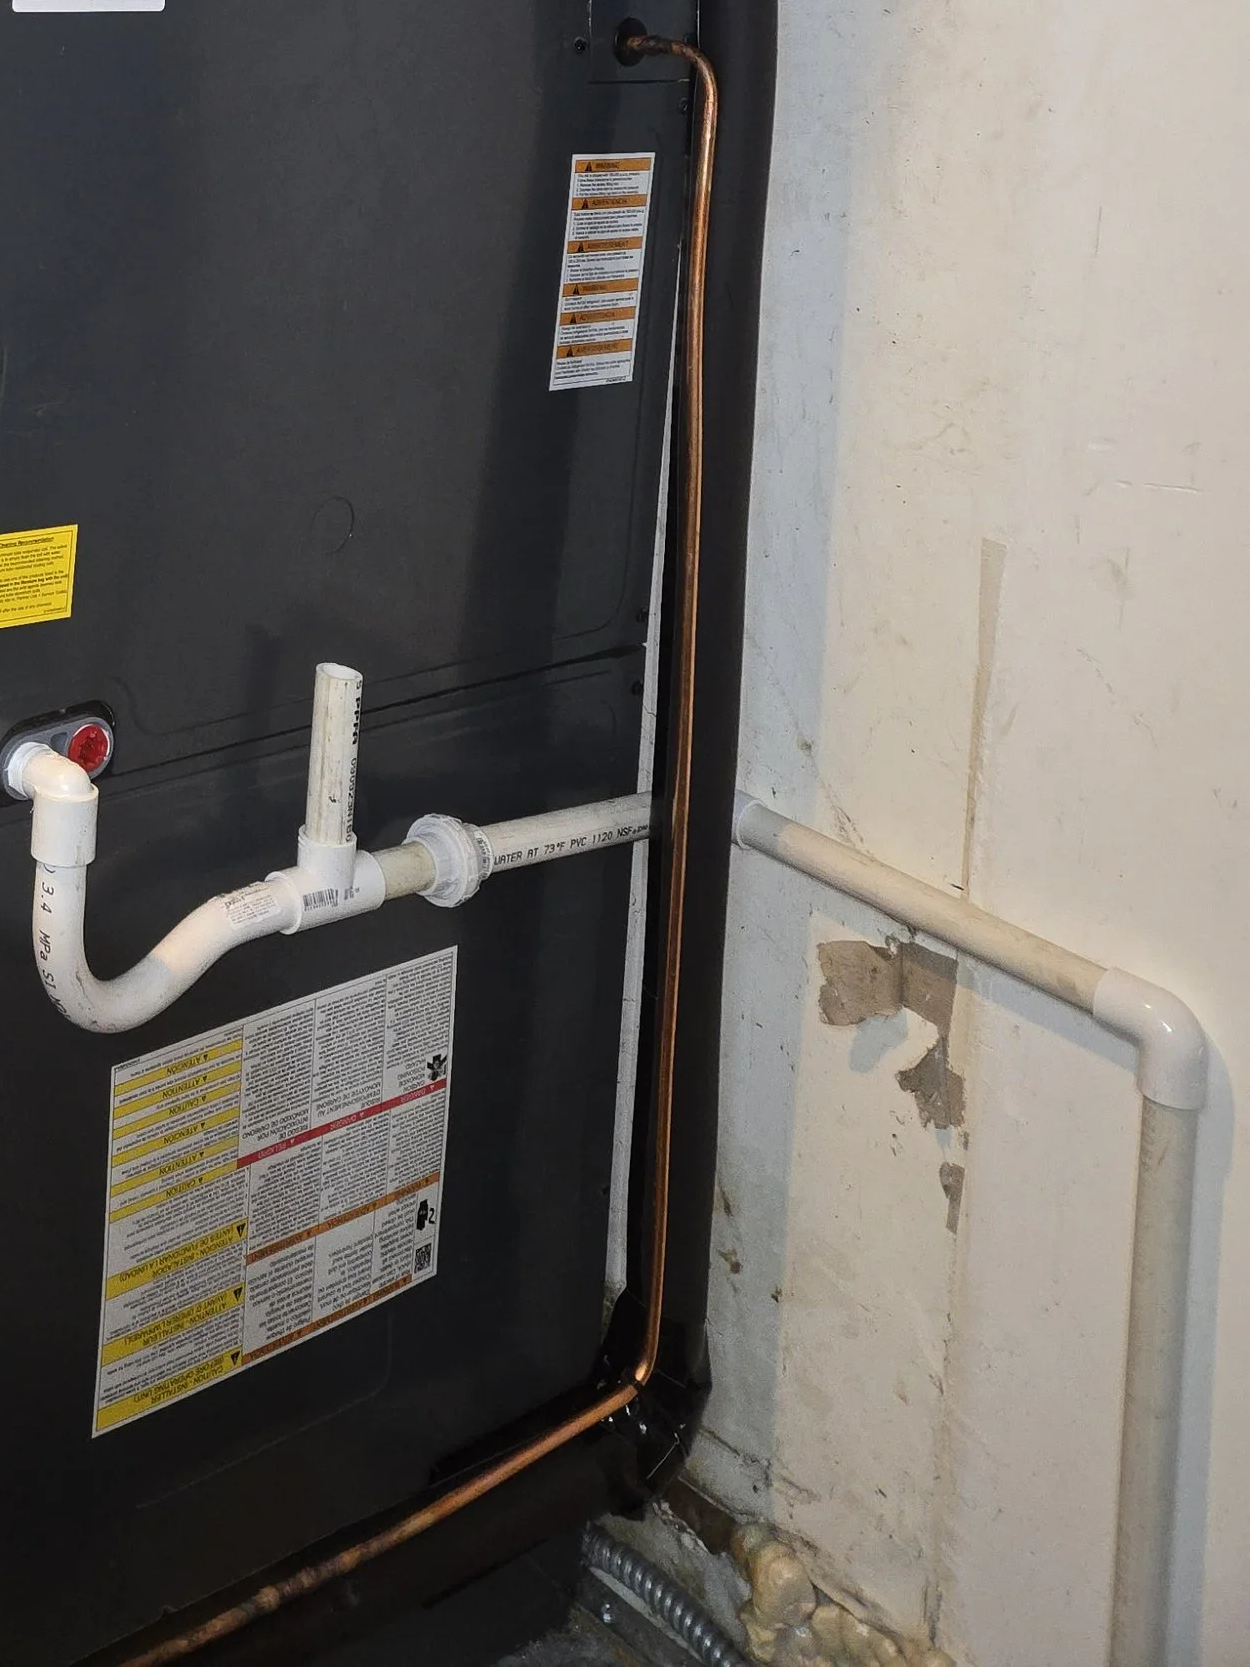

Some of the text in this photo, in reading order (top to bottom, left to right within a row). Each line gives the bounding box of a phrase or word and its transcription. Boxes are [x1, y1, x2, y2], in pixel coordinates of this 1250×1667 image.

[493, 850, 523, 865] WATER
[526, 847, 539, 858] AT
[570, 837, 587, 849] PVC
[39, 929, 51, 961] MPa
